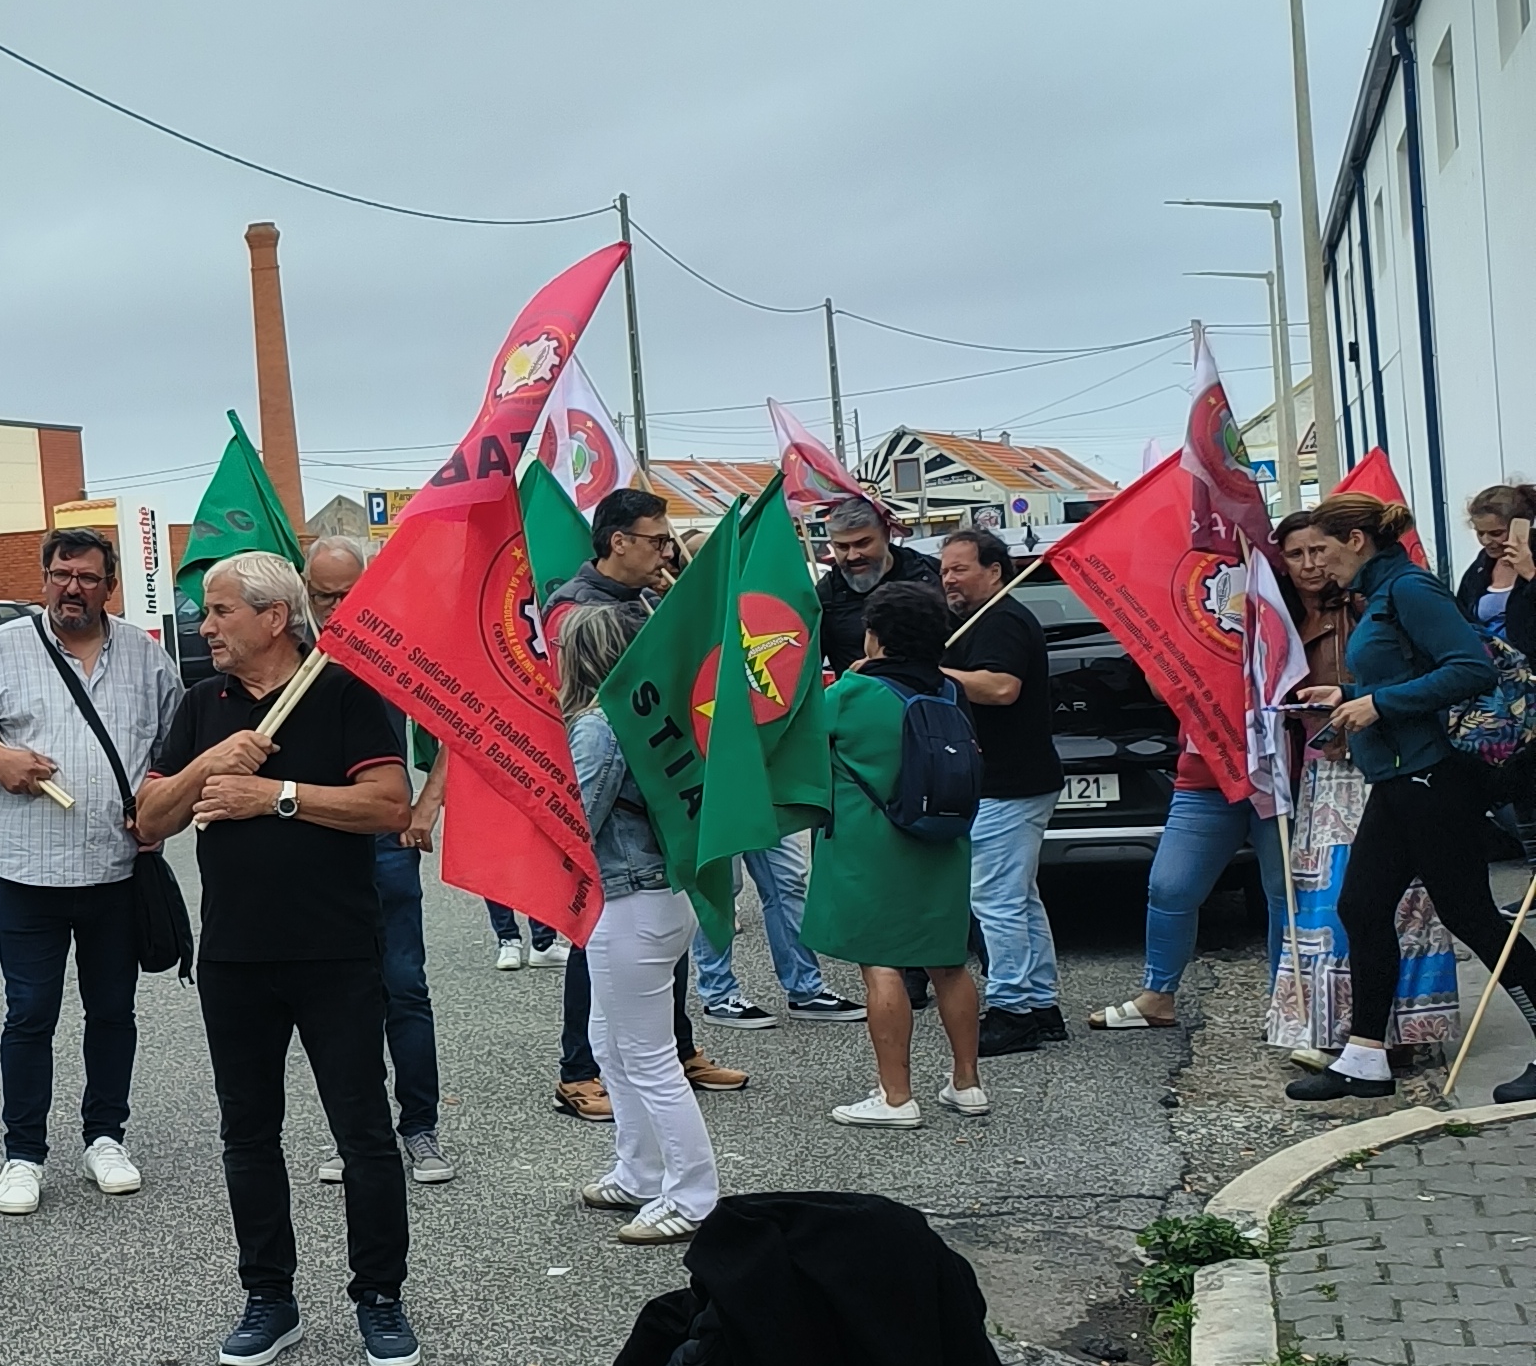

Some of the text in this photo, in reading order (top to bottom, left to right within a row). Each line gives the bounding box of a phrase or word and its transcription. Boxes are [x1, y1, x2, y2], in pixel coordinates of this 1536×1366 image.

[372, 497, 384, 522] P
[357, 608, 404, 648] SINTAB
[408, 647, 462, 695] Sindicato
[460, 690, 485, 714] dos
[484, 707, 567, 785] Trabalhadores
[493, 622, 532, 687] CONSTRUIR
[344, 630, 398, 677] Indústrias
[396, 671, 413, 689] de
[411, 682, 484, 750] Alimentação,
[485, 742, 535, 790] Bebidas
[534, 785, 546, 798] e
[545, 791, 590, 843] Tabacos
